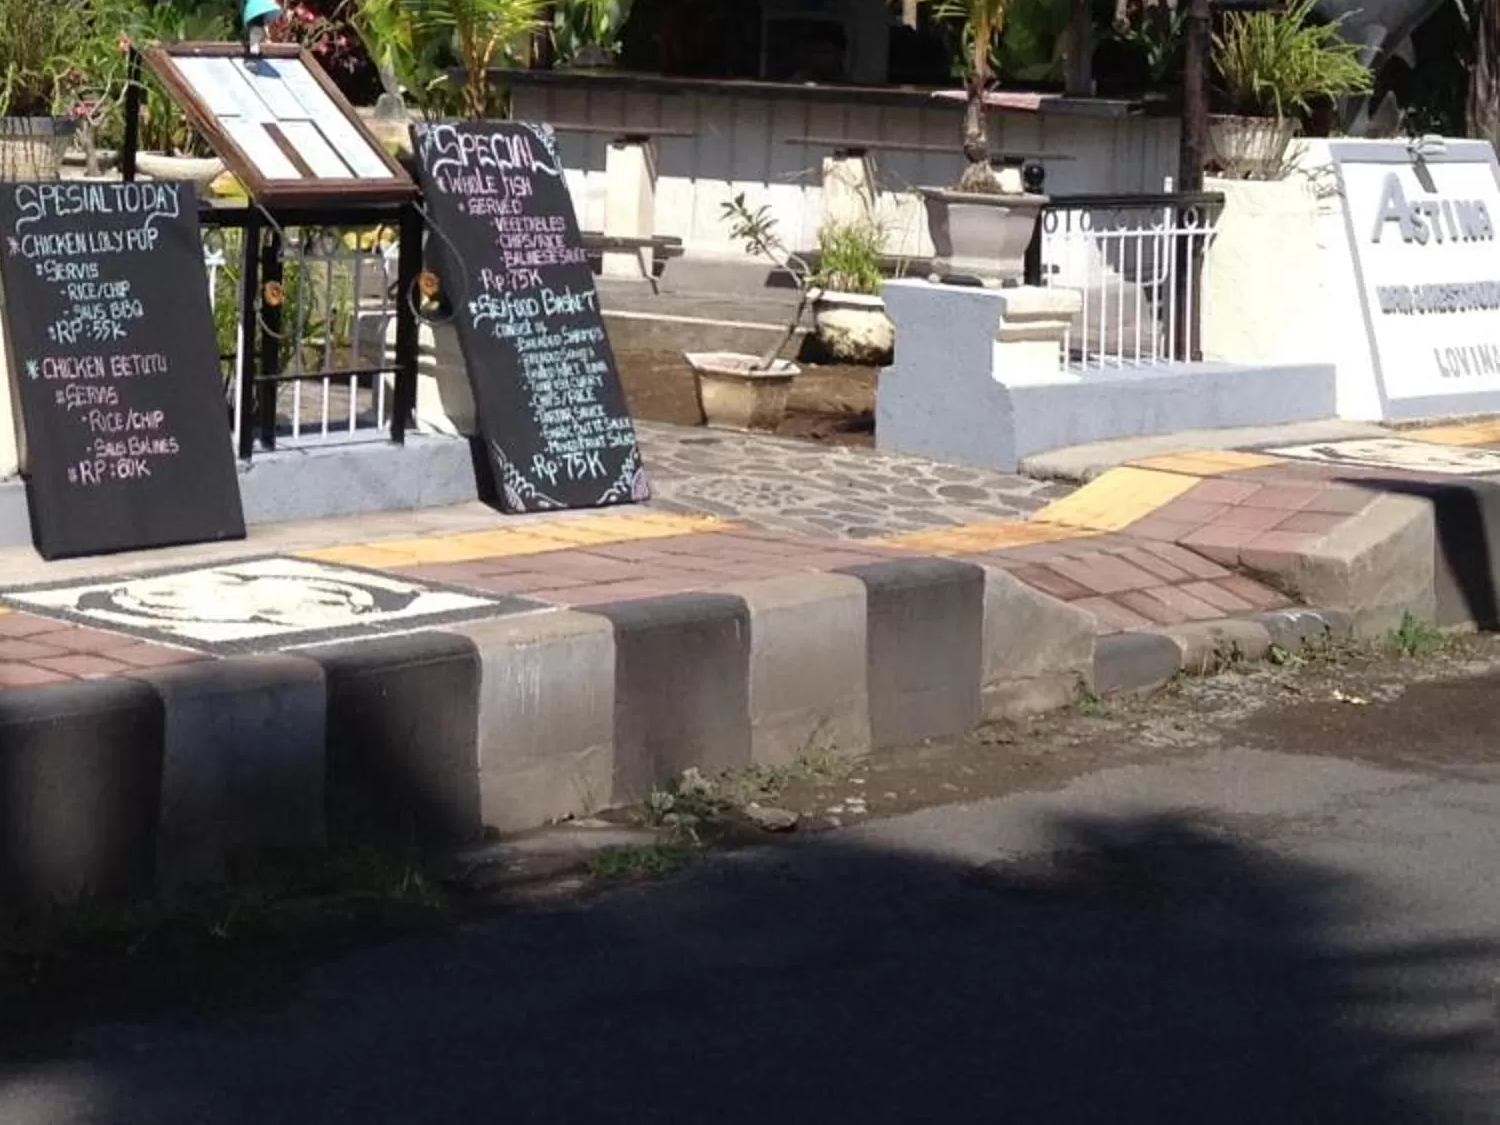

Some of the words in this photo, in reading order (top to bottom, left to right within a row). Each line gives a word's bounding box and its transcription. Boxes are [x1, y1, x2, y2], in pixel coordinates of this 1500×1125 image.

[432, 125, 562, 175] SPECIAL
[113, 183, 180, 225] TODAY
[21, 233, 87, 258] CHICKEN
[127, 228, 159, 251] POP
[43, 259, 99, 281] SERVIS
[42, 356, 104, 379] CHICKEN
